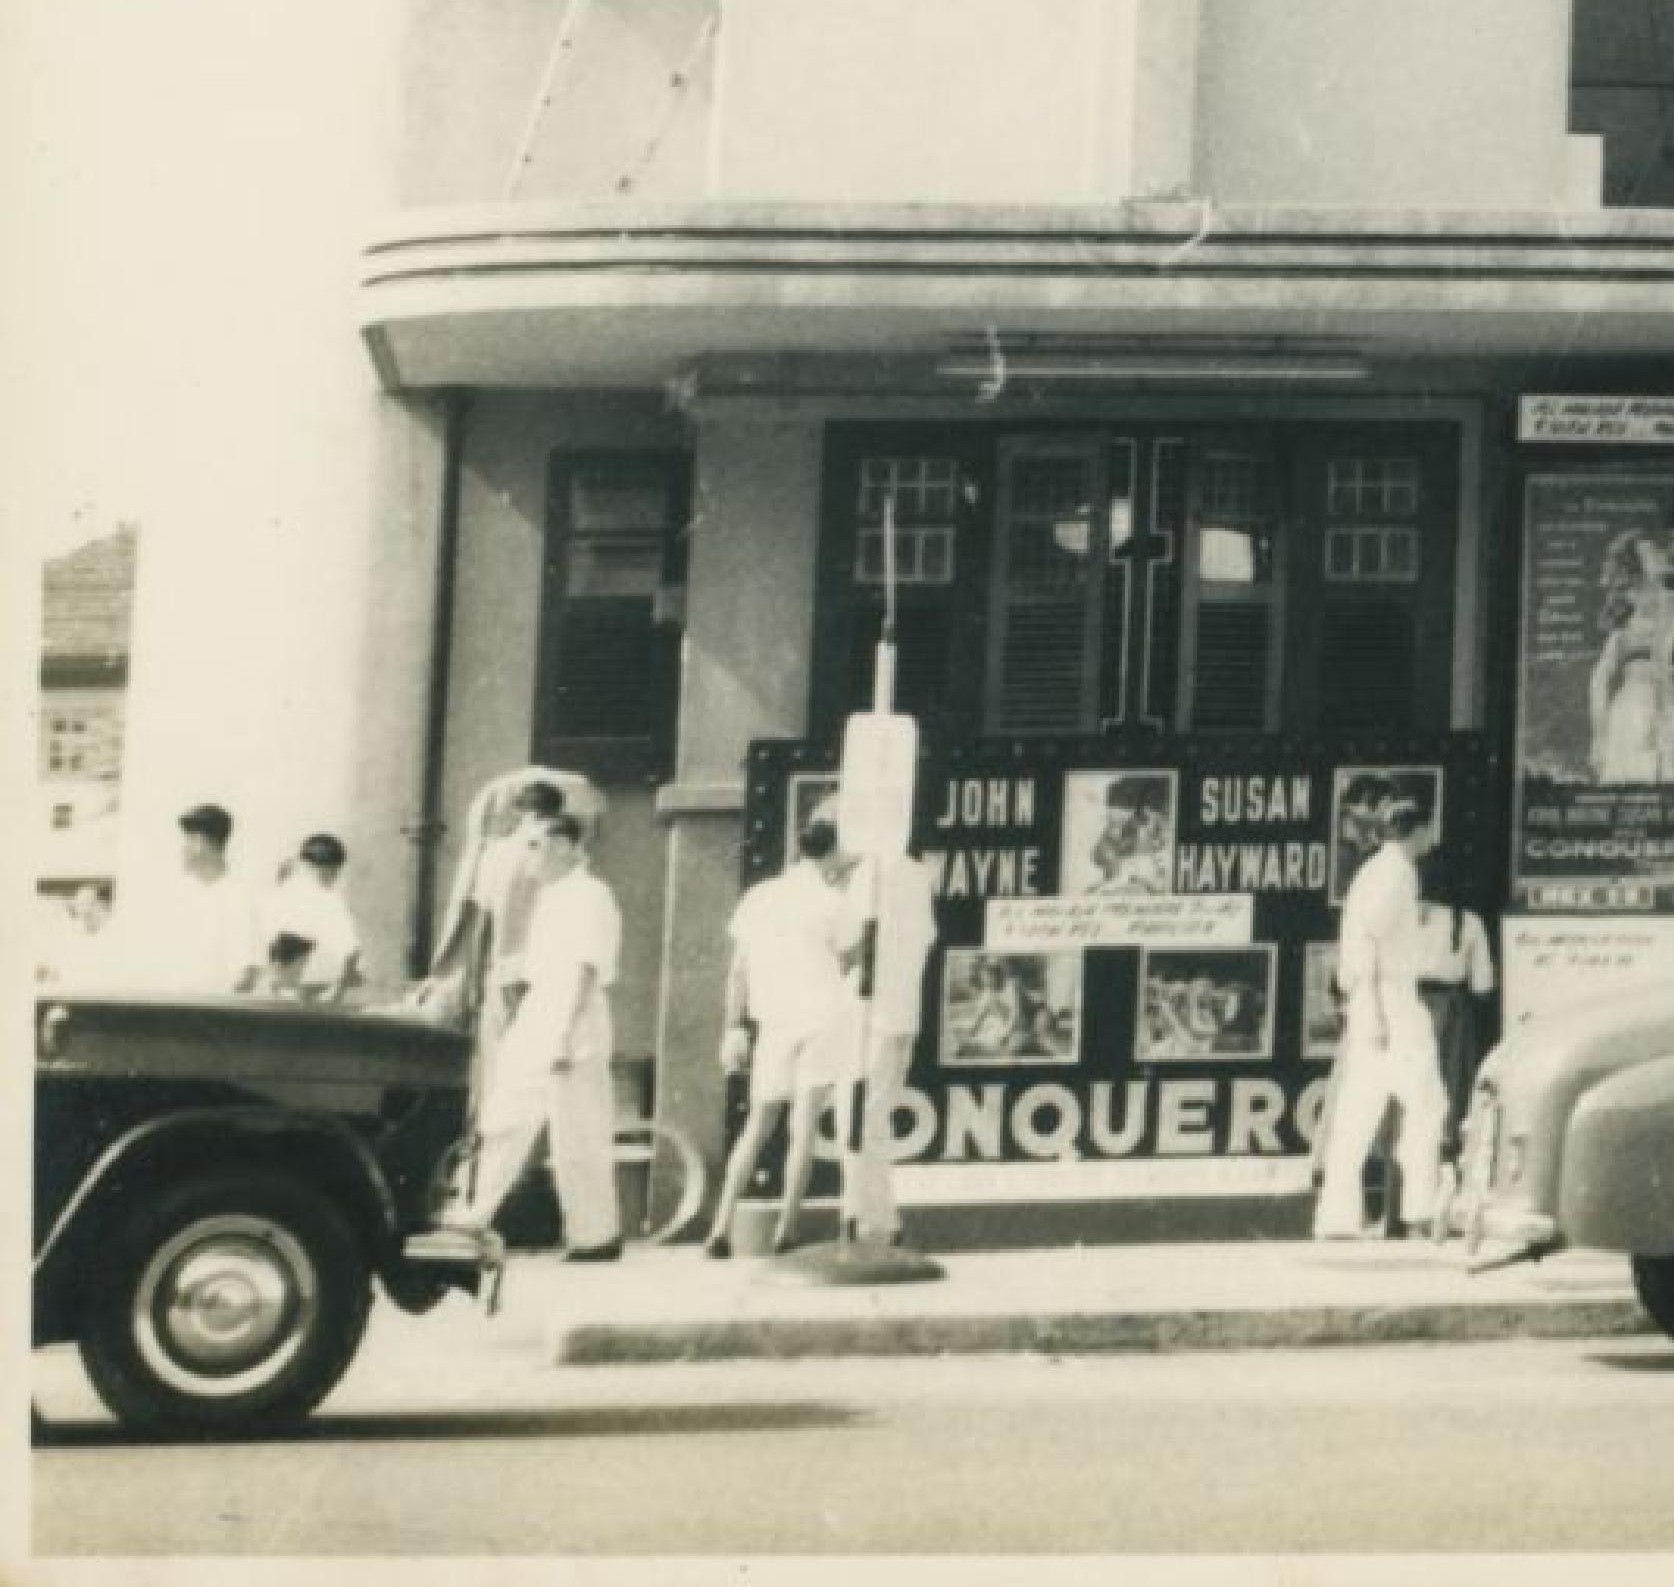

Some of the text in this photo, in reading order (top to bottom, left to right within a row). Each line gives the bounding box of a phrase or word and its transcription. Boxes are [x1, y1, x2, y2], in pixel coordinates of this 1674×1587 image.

[936, 778, 1036, 829] JOHN
[1200, 775, 1312, 827] SUSAN
[1176, 841, 1327, 893] HAYWARD
